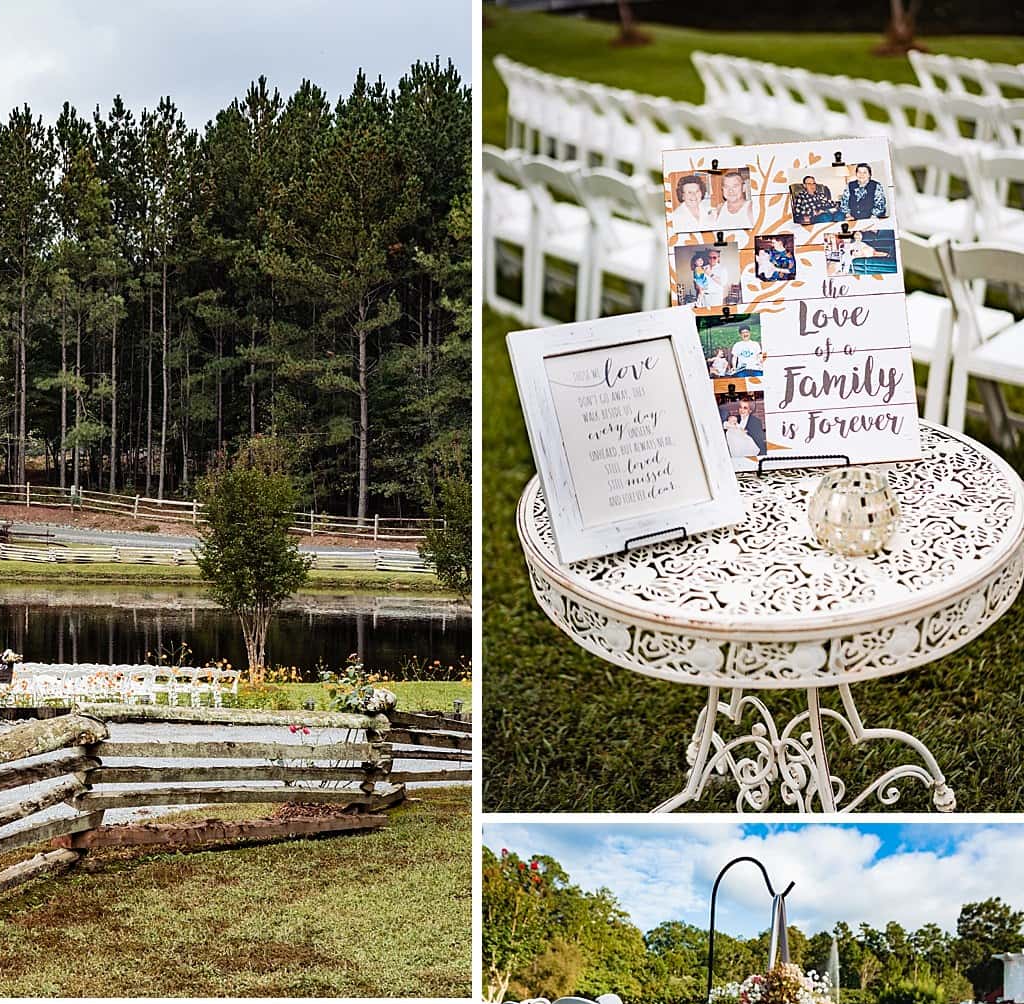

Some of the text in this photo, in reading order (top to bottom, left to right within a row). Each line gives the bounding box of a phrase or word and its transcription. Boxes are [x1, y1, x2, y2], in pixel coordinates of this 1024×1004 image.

[822, 279, 849, 297] the
[799, 300, 869, 336] Love
[814, 338, 857, 362] of a
[603, 356, 659, 388] love
[778, 355, 904, 409] Family
[588, 410, 658, 440] every day
[781, 410, 905, 444] is Forever
[626, 462, 671, 486] missed
[627, 451, 659, 474] loved
